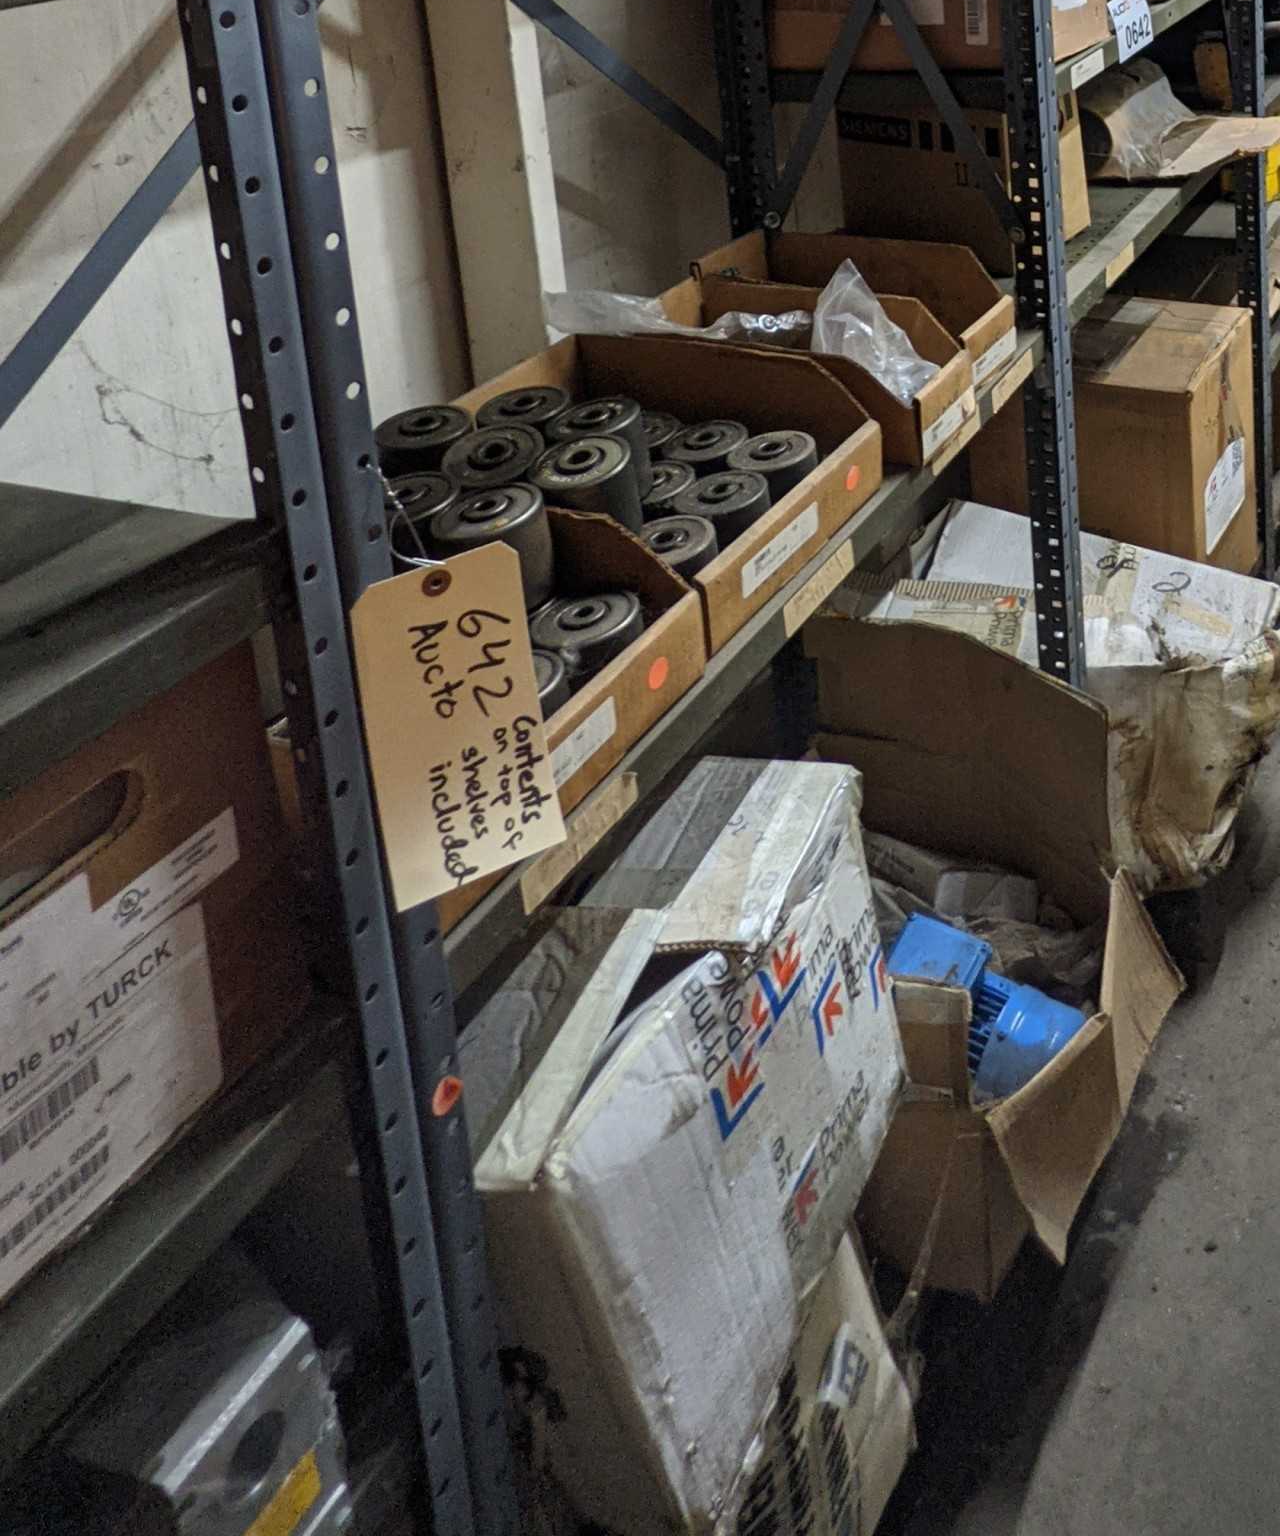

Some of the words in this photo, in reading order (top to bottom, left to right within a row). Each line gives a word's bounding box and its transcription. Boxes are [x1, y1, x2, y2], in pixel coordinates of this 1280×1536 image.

[1125, 13, 1152, 50] 0642
[407, 619, 465, 720] Aucto
[456, 607, 513, 717] 642
[492, 763, 514, 809] top
[493, 726, 509, 755] on
[428, 762, 479, 886] included
[460, 745, 491, 839] shelves
[501, 818, 526, 851] of
[49, 1019, 81, 1055] by
[86, 937, 175, 1020] TURCK
[707, 950, 752, 1054] Powe
